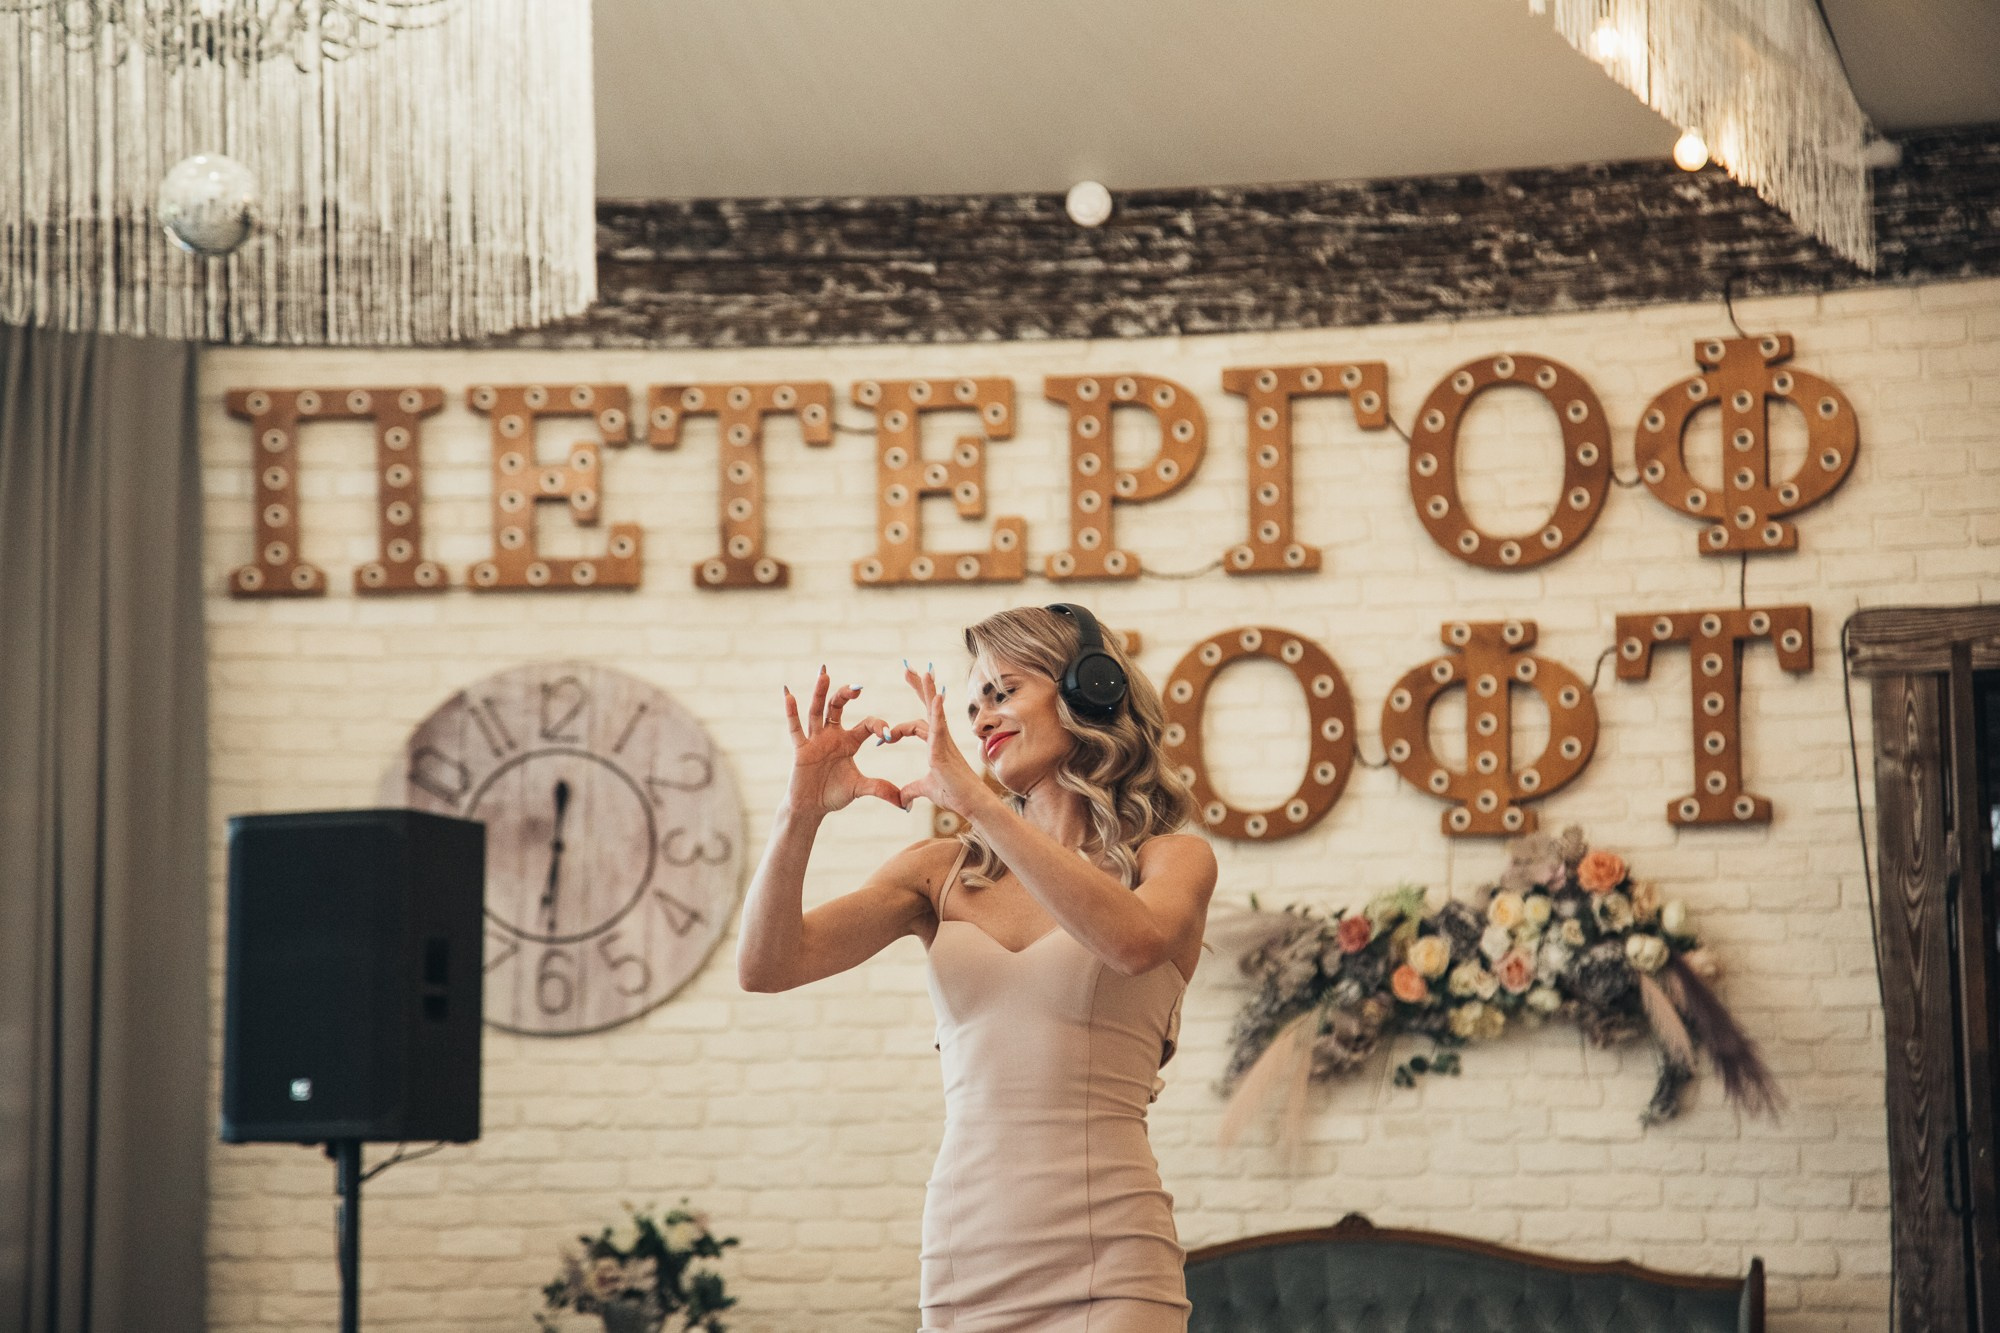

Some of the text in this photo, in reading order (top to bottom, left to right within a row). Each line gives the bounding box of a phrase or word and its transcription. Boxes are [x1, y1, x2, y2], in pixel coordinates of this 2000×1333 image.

[226, 333, 1860, 596] ПЕТЕРГОФ
[539, 674, 587, 744] 12
[605, 701, 649, 754] 1
[933, 606, 1814, 841] ОФТ
[645, 752, 715, 808] 2
[661, 827, 733, 868] 3
[652, 888, 709, 938] 4
[535, 949, 574, 1017] 6
[597, 930, 653, 998] 5
